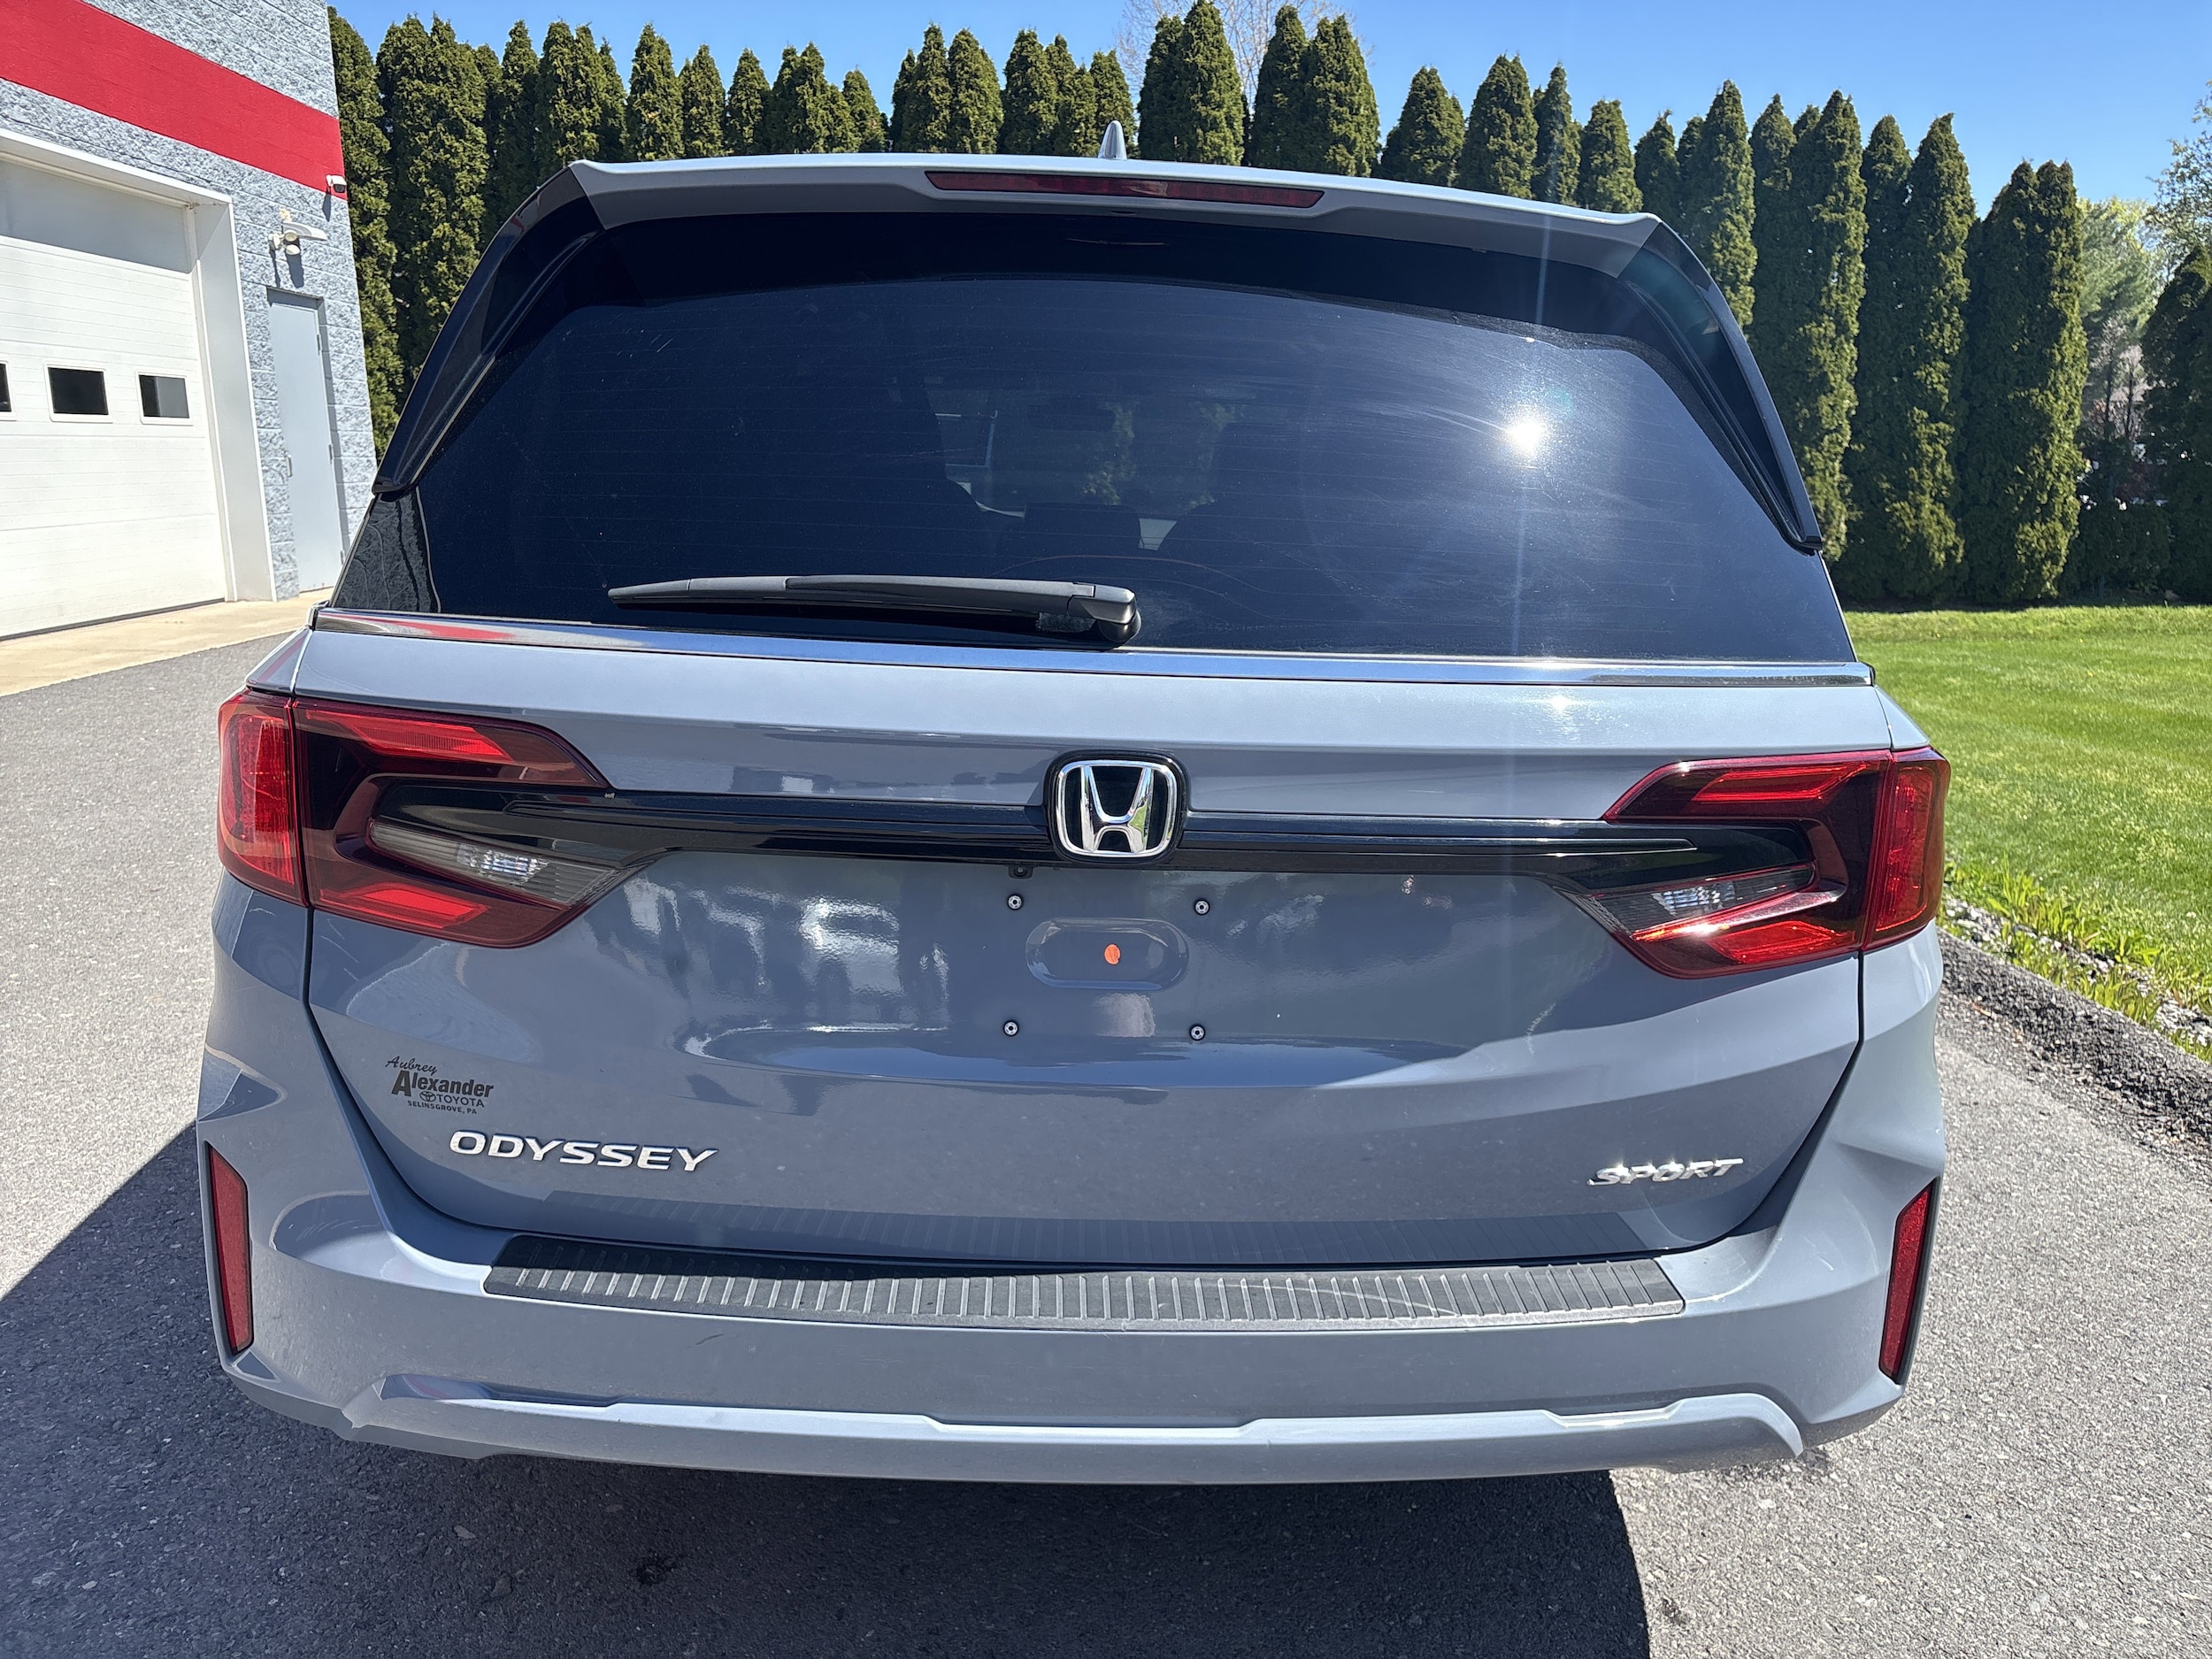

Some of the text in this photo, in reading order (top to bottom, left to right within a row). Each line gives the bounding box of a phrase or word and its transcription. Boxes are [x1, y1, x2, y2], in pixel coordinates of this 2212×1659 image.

[385, 1056, 437, 1076] Aubrey
[391, 1070, 494, 1098] Alexander
[407, 1100, 465, 1114] SELINSGROVE,
[436, 1094, 485, 1108] TOYOTA
[449, 1130, 718, 1171] ODYSSEY
[1586, 1158, 1744, 1186] SPORT
